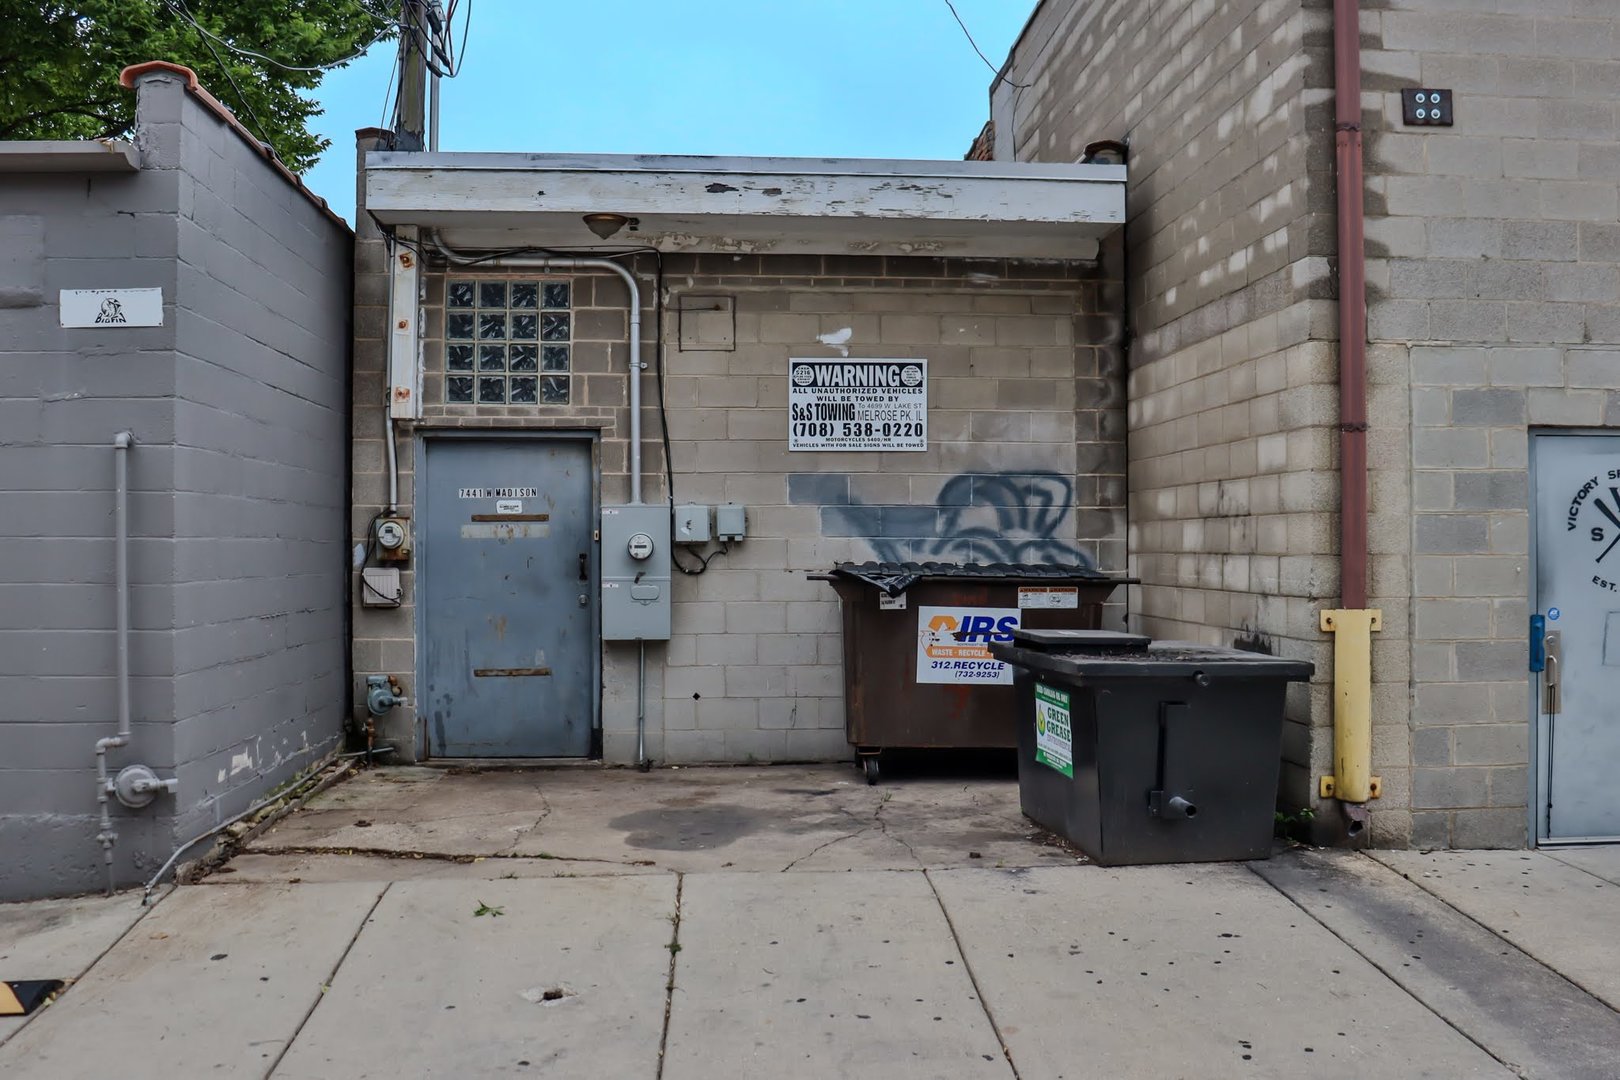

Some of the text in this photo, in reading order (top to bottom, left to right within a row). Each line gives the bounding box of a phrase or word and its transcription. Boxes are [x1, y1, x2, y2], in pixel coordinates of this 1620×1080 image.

[814, 365, 900, 386] WARNING
[792, 403, 856, 421] S&S TOWING
[858, 410, 898, 421] MELROSE
[916, 410, 922, 421] IL
[793, 422, 923, 437] (708) 538-0220
[460, 489, 482, 497] 7441
[496, 488, 537, 496] MADISON
[1568, 476, 1599, 531] VICTORY
[1592, 576, 1617, 592] EST.
[959, 616, 1018, 642] IRS
[931, 661, 1005, 670] 312.RECYCLE
[1048, 706, 1069, 727] GREEN
[1047, 721, 1070, 742] GREASE
